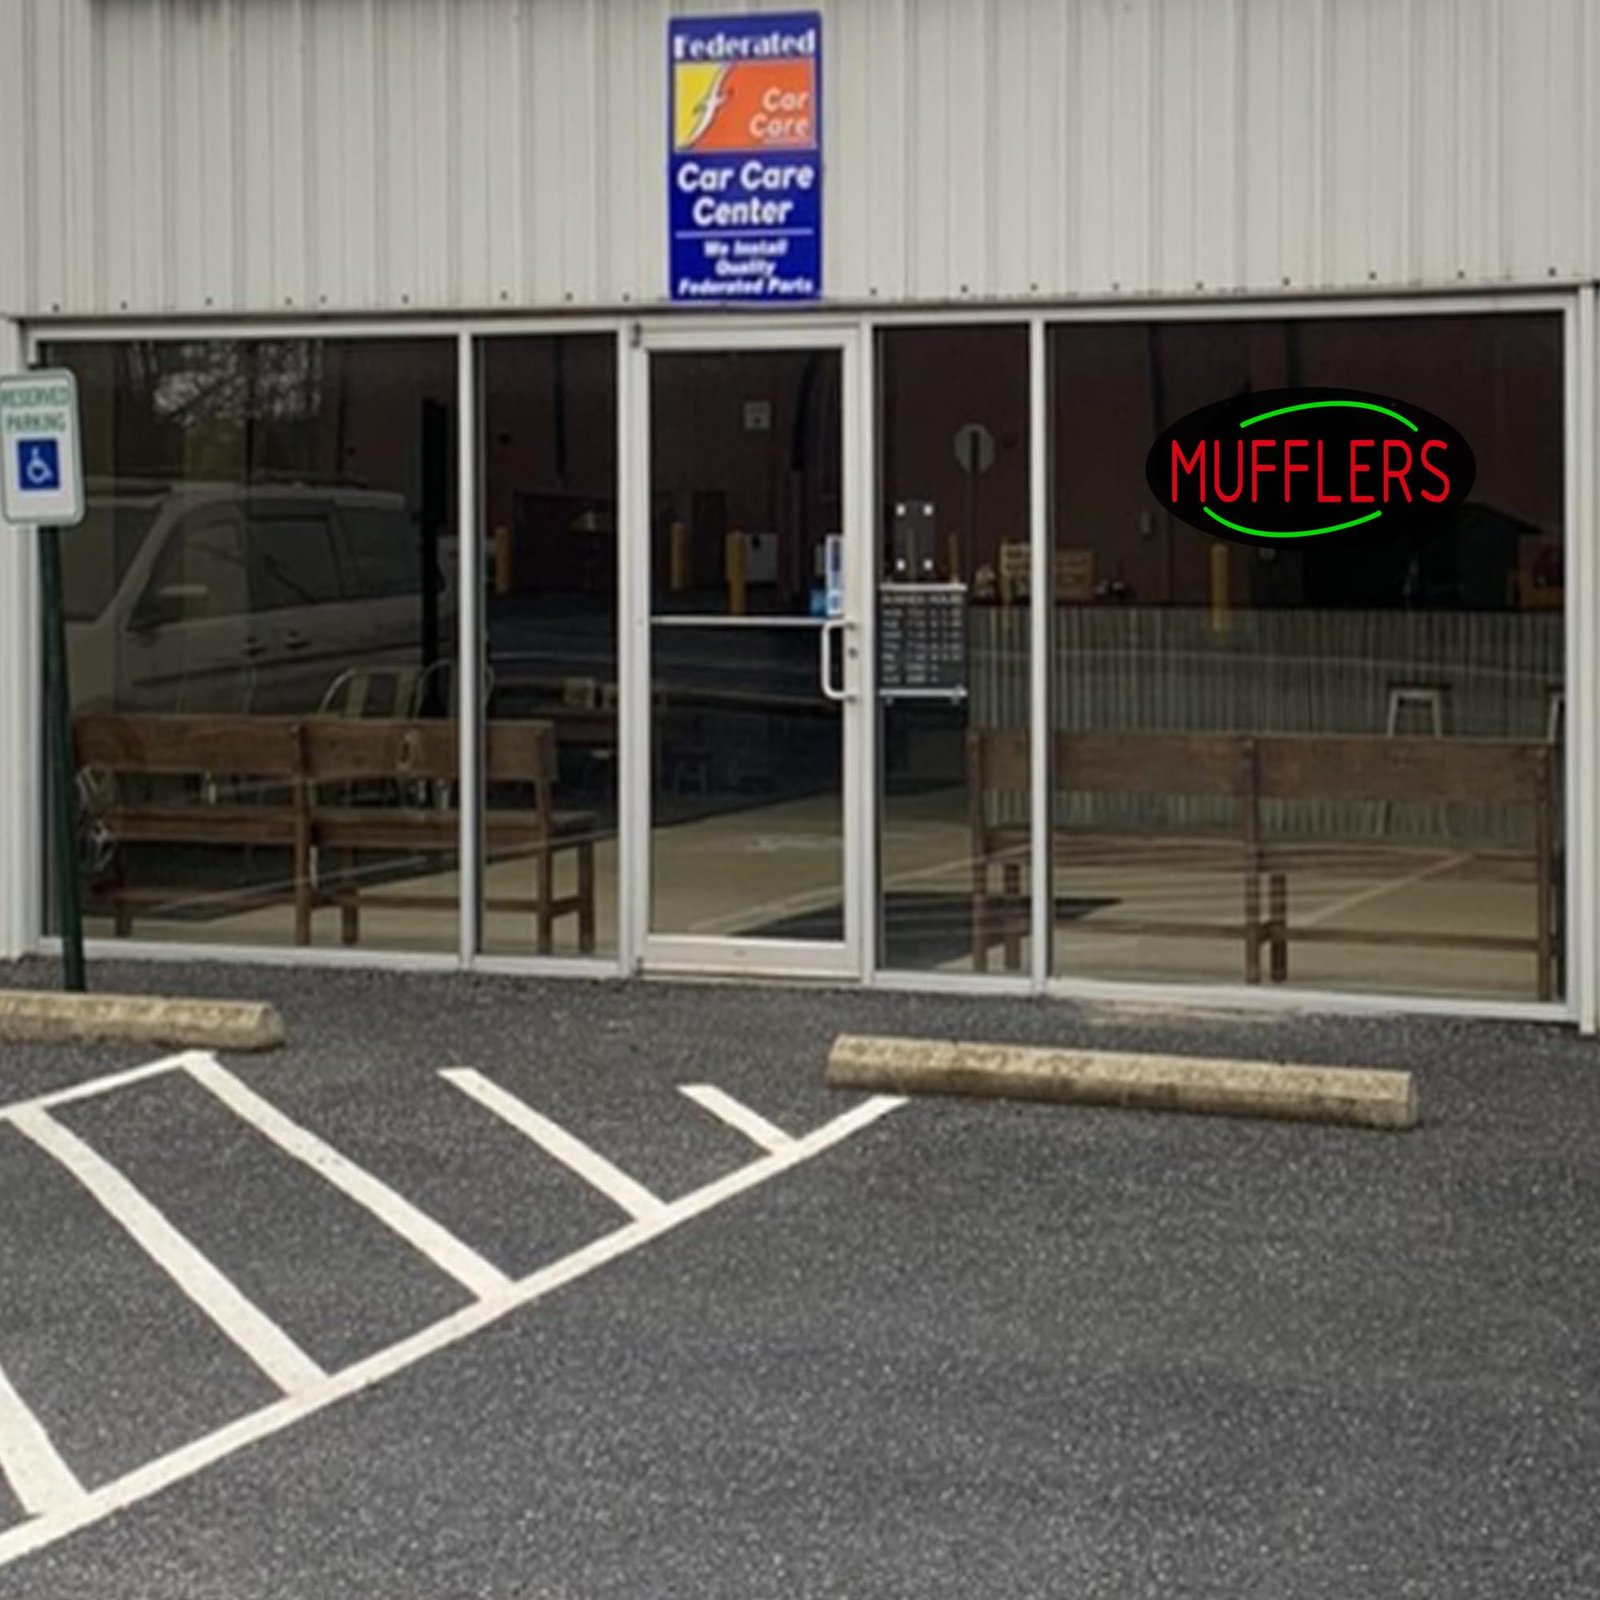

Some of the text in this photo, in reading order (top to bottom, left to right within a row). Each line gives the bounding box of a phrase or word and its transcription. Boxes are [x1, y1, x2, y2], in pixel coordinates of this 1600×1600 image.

[674, 28, 816, 59] Federated
[762, 86, 809, 112] Car
[749, 112, 809, 138] Care
[677, 160, 815, 193] Car Care
[692, 196, 794, 227] Center
[715, 258, 777, 277] Quality
[678, 276, 814, 295] Federated Parts
[0, 385, 71, 408] RESERVED
[7, 411, 66, 433] PARKING
[1171, 439, 1451, 503] MUFFLERS
